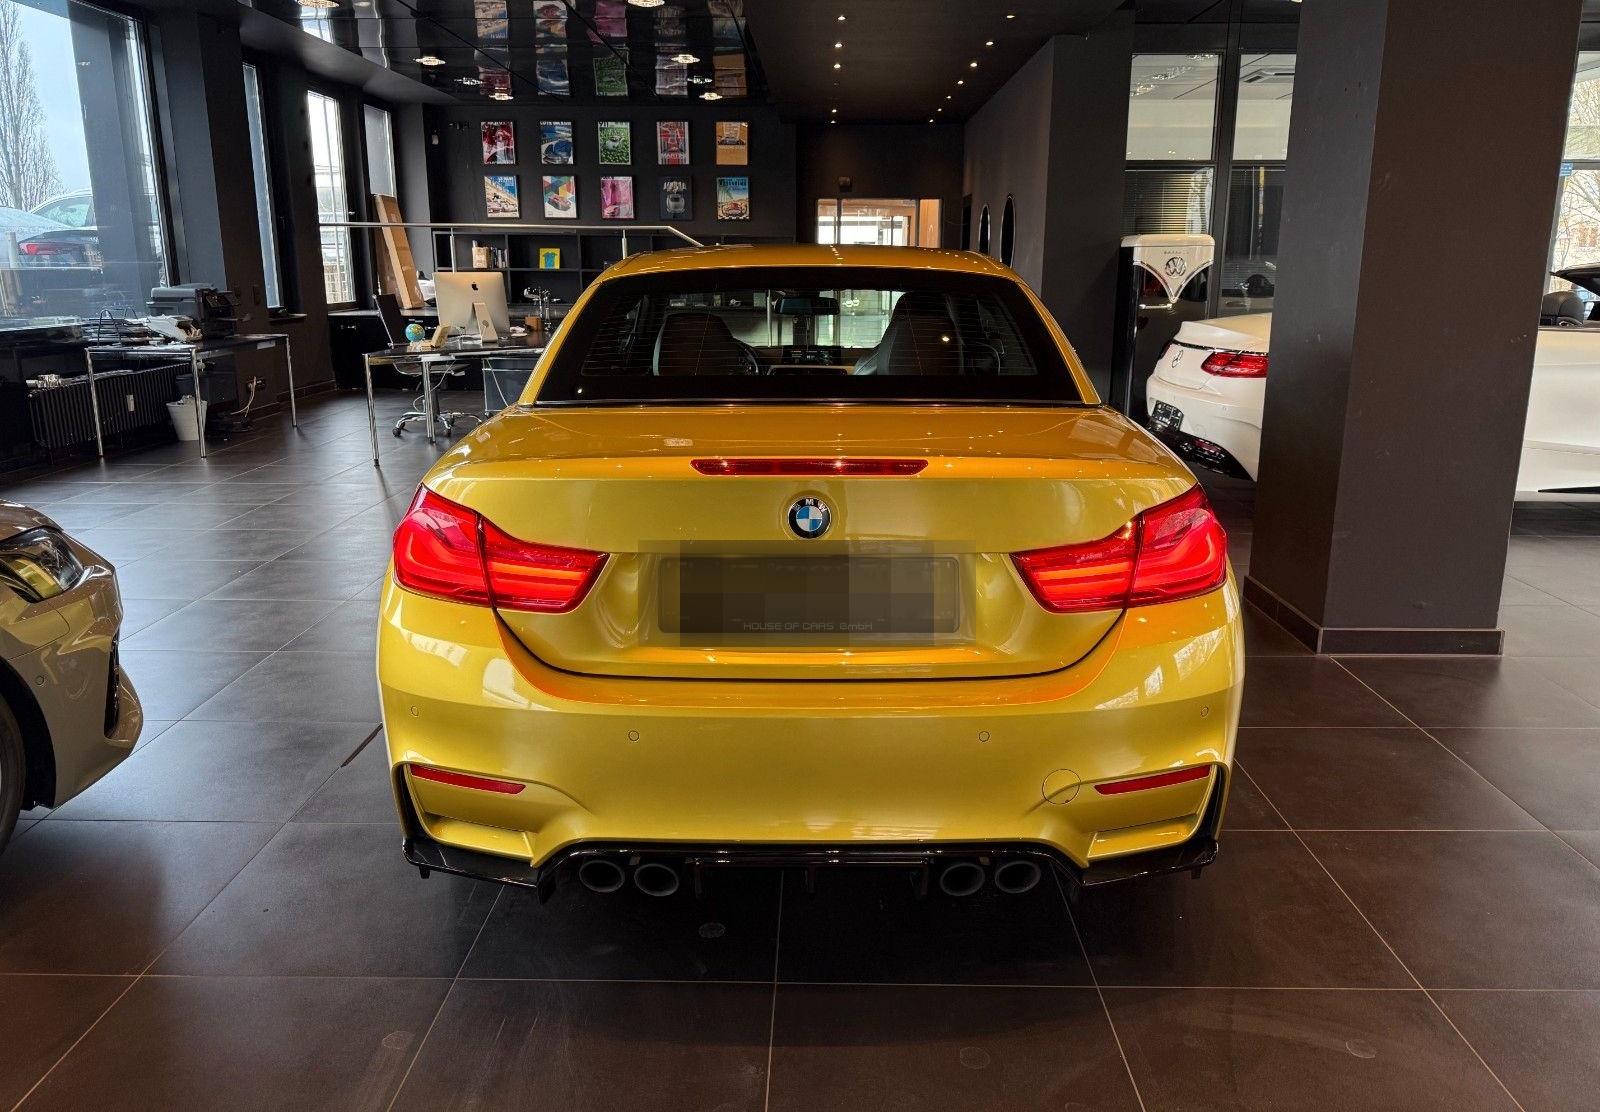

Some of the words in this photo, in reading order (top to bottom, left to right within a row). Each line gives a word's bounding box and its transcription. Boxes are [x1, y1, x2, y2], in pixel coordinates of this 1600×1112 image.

[743, 622, 781, 630] HOUSE
[785, 622, 800, 630] OF
[802, 622, 834, 630] CARS
[840, 622, 873, 630] GmbH
